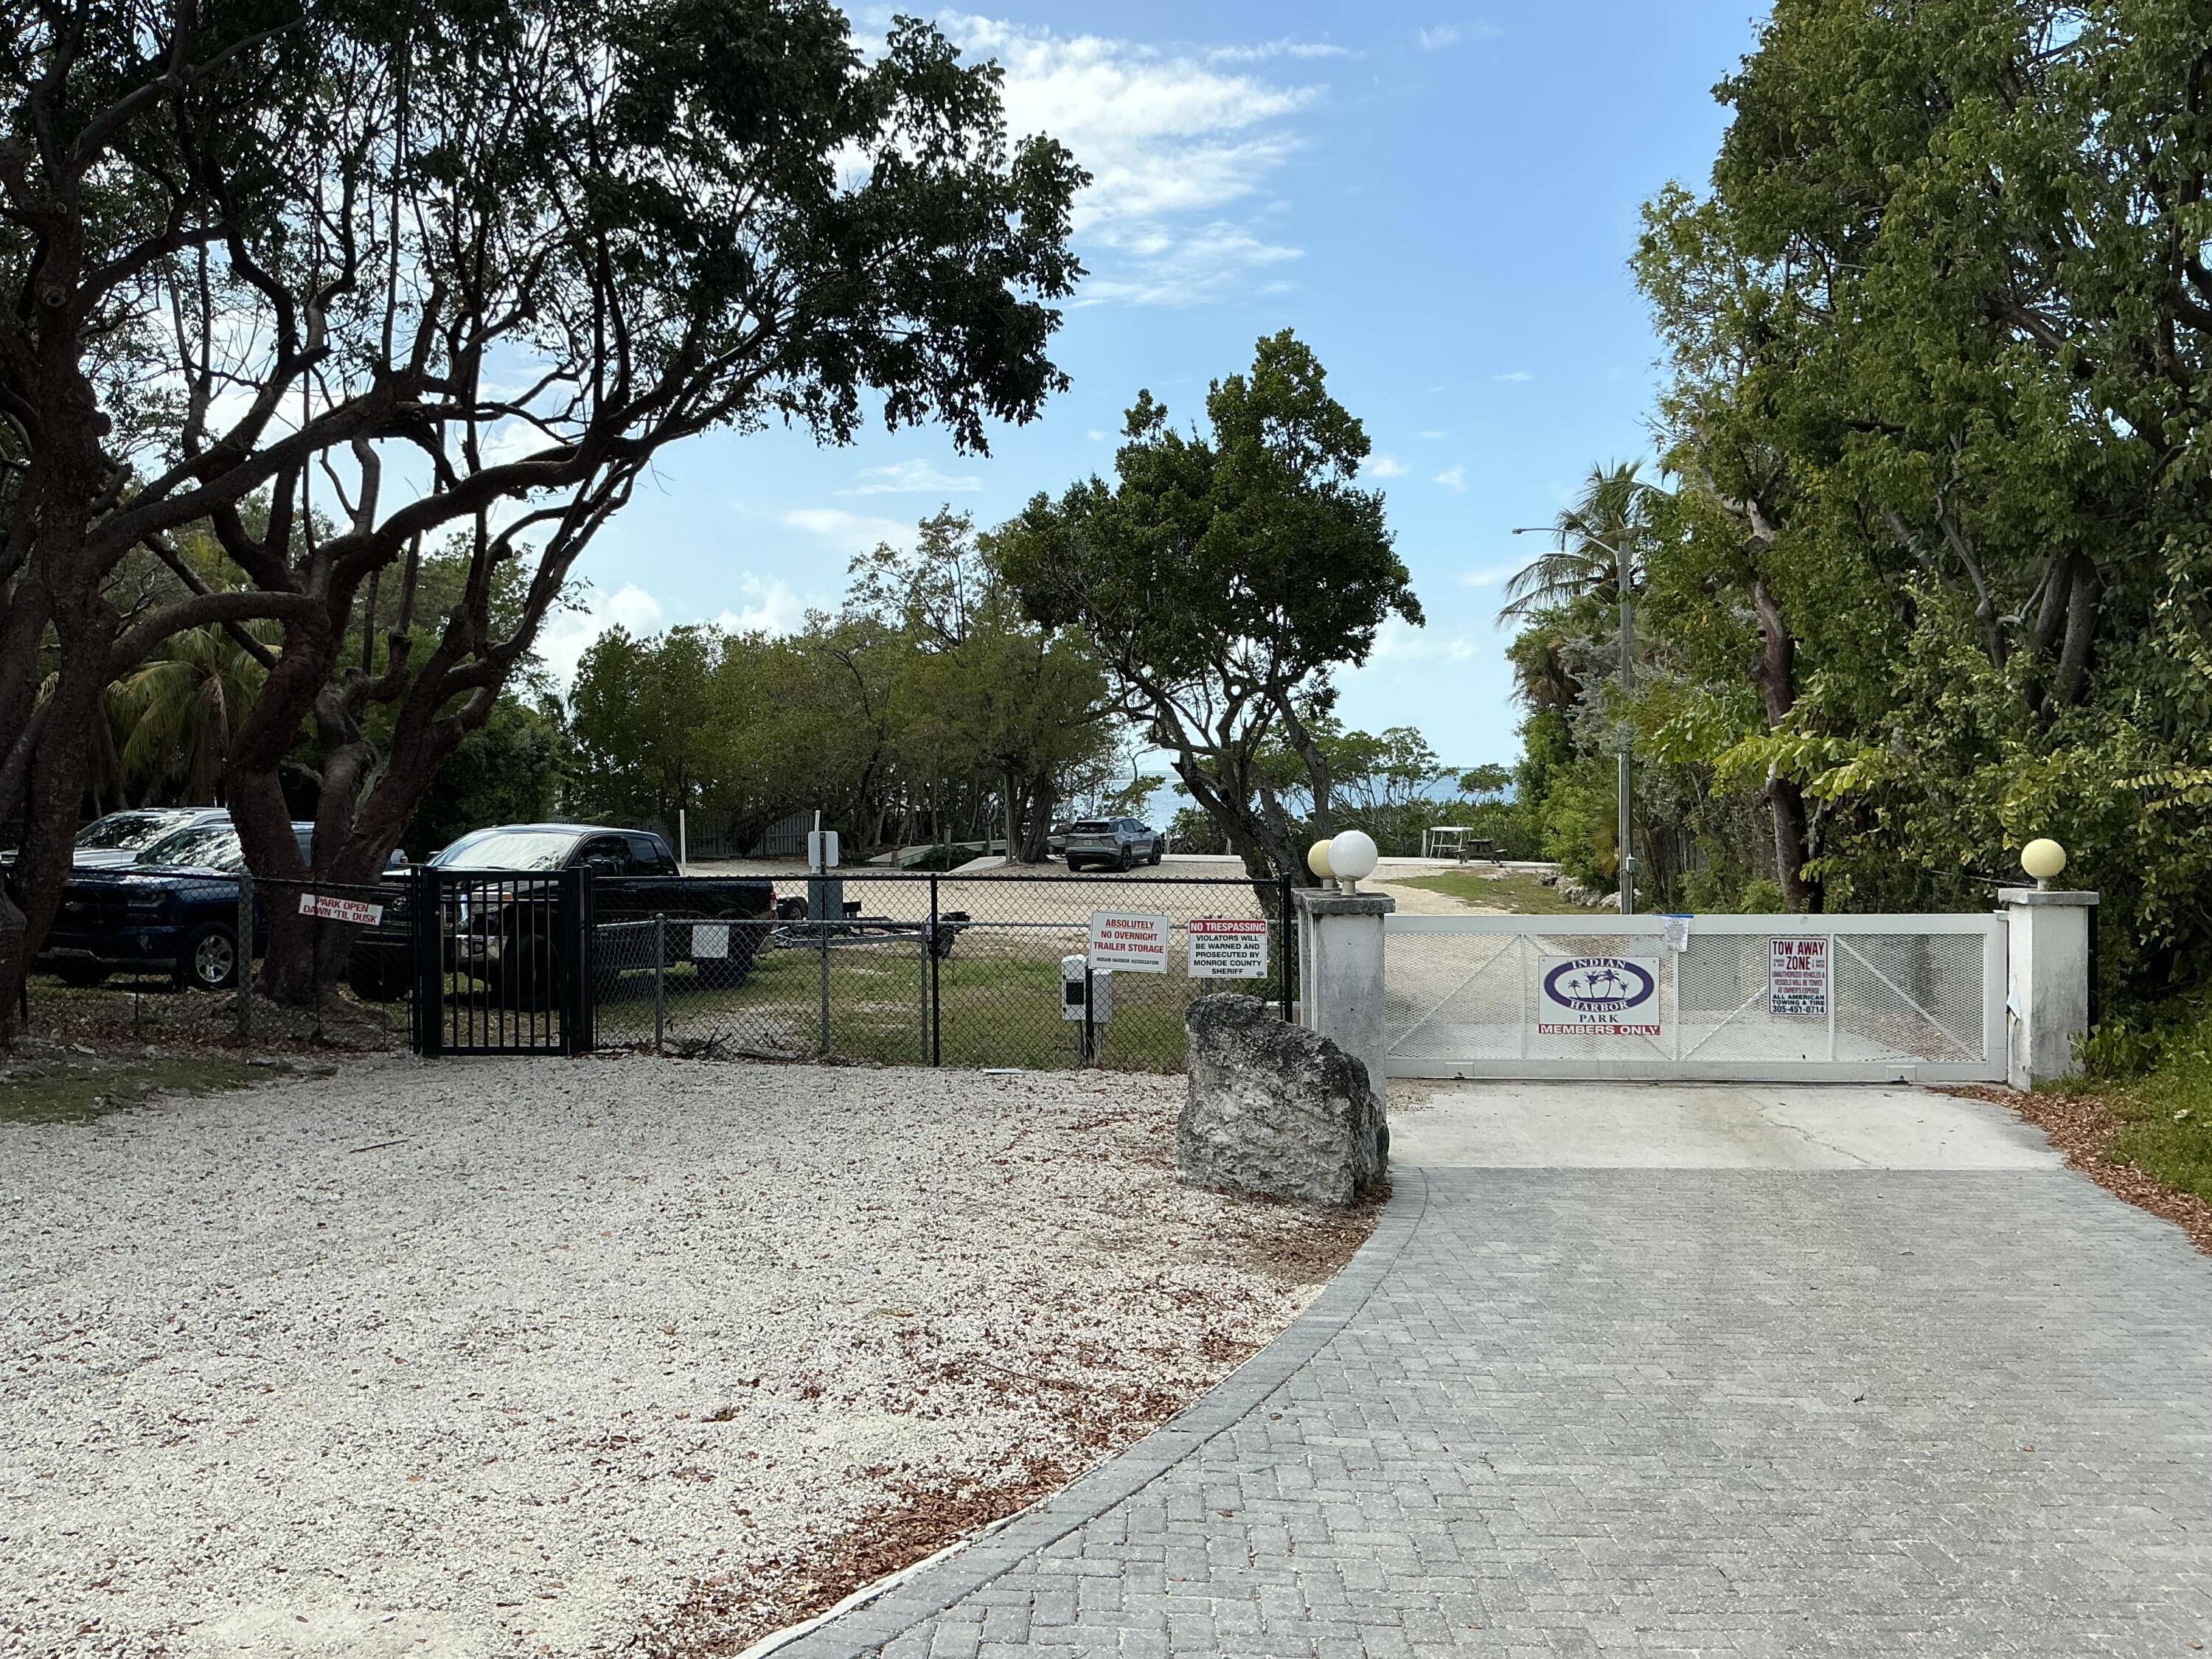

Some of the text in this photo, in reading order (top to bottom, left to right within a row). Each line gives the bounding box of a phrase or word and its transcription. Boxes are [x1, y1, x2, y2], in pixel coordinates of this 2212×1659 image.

[316, 897, 369, 912] PARK OPEN
[303, 905, 330, 916] DAWN
[352, 913, 377, 923] DUSK
[1105, 919, 1155, 929] ABSOLUTELY
[1191, 922, 1265, 932] NO TRESPASSING
[1101, 931, 1158, 942] NO OVERNIGHT
[1093, 942, 1164, 953] TRAILER STORAGE
[1773, 941, 1824, 955] TOW AWAY
[1572, 959, 1627, 969] INDIAN
[1787, 956, 1810, 970] ZONE
[1570, 1001, 1629, 1012] HARBOR
[1579, 1015, 1618, 1023] PARK
[1540, 1025, 1658, 1034] MEMBERS ONLY
